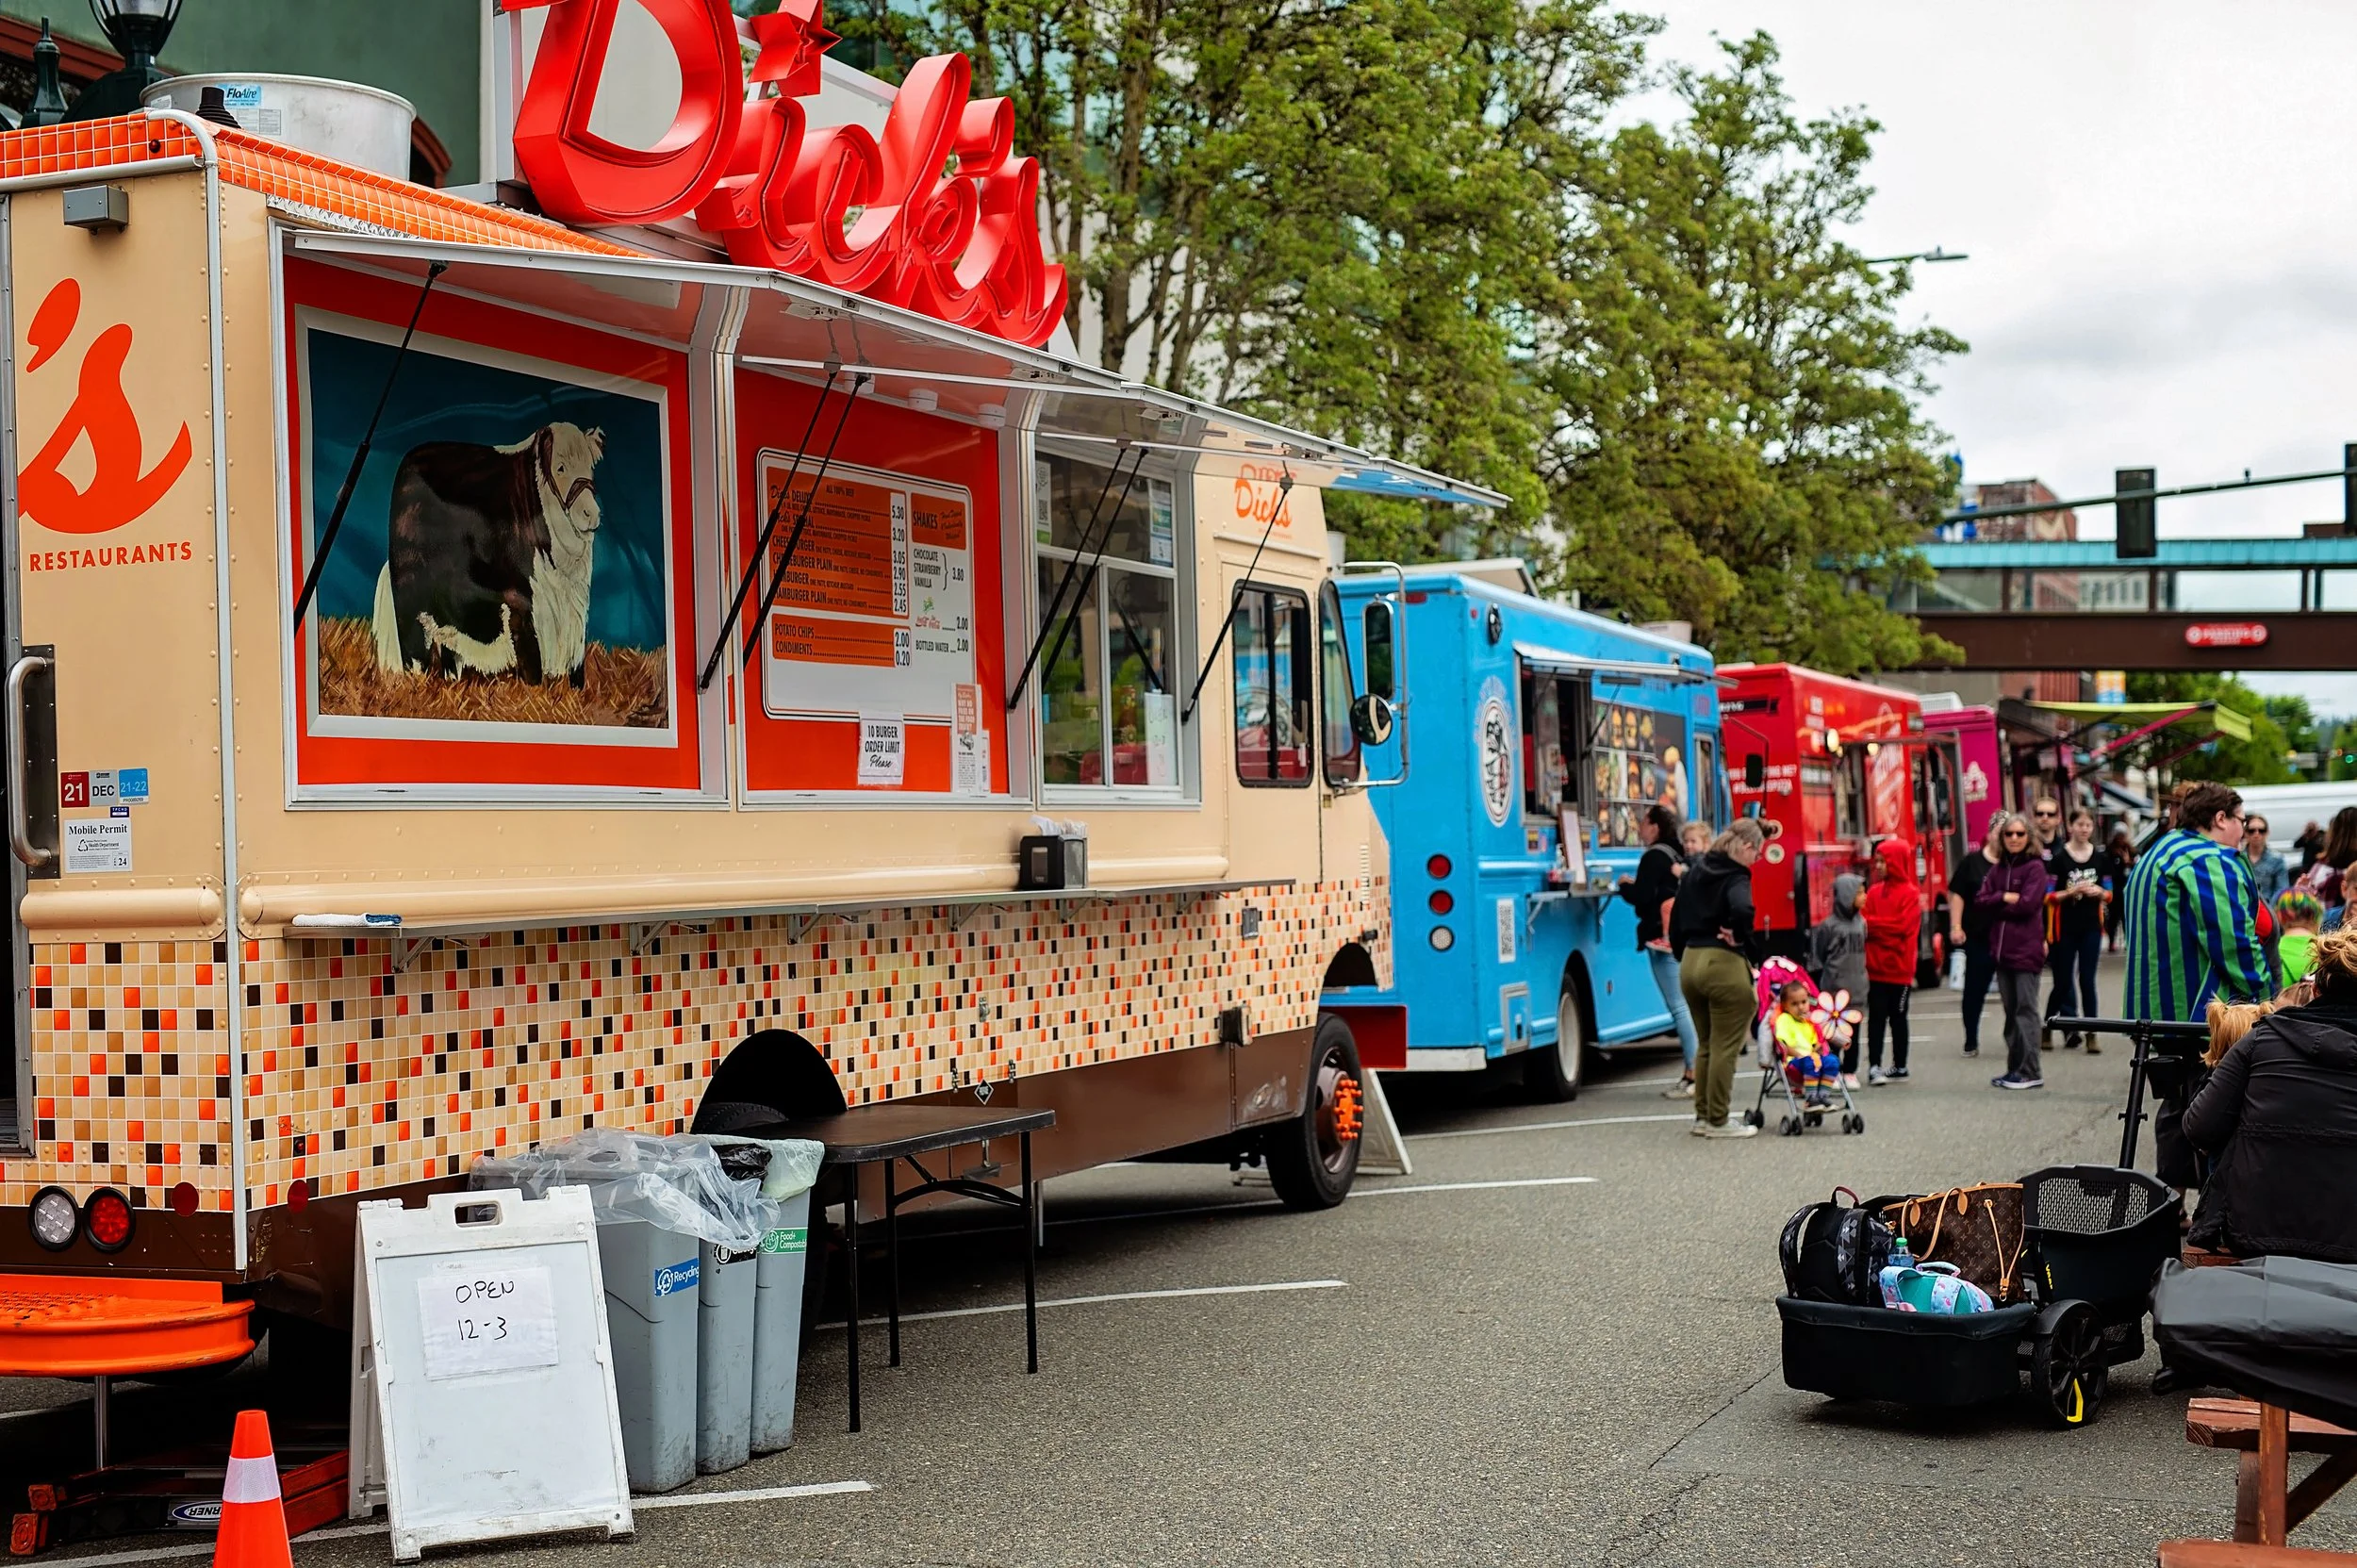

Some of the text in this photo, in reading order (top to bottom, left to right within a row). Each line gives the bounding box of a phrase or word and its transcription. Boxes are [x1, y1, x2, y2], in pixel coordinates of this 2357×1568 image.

[792, 490, 813, 504] DELUX
[1234, 478, 1293, 528] Dicks
[913, 510, 938, 529] SHAKES
[892, 528, 905, 542] 3.20
[30, 541, 192, 572] RESTAURANTS
[773, 535, 815, 552] CHEEURGER
[893, 550, 905, 564] 3.05
[914, 548, 938, 561] CHOCOLATE
[773, 552, 816, 569] CHEBURGER
[816, 558, 832, 570] PLAIN
[893, 566, 906, 580] 2.90
[914, 562, 941, 576] STRAWBERRY
[774, 569, 809, 585] MBURGER
[894, 582, 906, 596] 2.55
[914, 577, 932, 588] VANILLA
[811, 590, 826, 603] PLAIN
[894, 598, 907, 612] 2.45
[956, 616, 969, 630] 2.00
[775, 623, 910, 648] POTATO CHIPS 2.00
[916, 638, 969, 652] BOTTLED WATER 2.00
[775, 641, 910, 666] CONDIMENTS 0.20
[868, 725, 898, 738] 10 BURGER
[865, 741, 900, 753] ORDER LIMIT
[870, 754, 893, 768] Please
[65, 783, 82, 801] 21
[92, 785, 115, 797] DEC
[69, 824, 127, 835] Mobile Permit
[118, 858, 127, 866] 24
[674, 1265, 699, 1283] Recycling
[456, 1280, 514, 1303] OPEN
[189, 1506, 222, 1516] RNER
